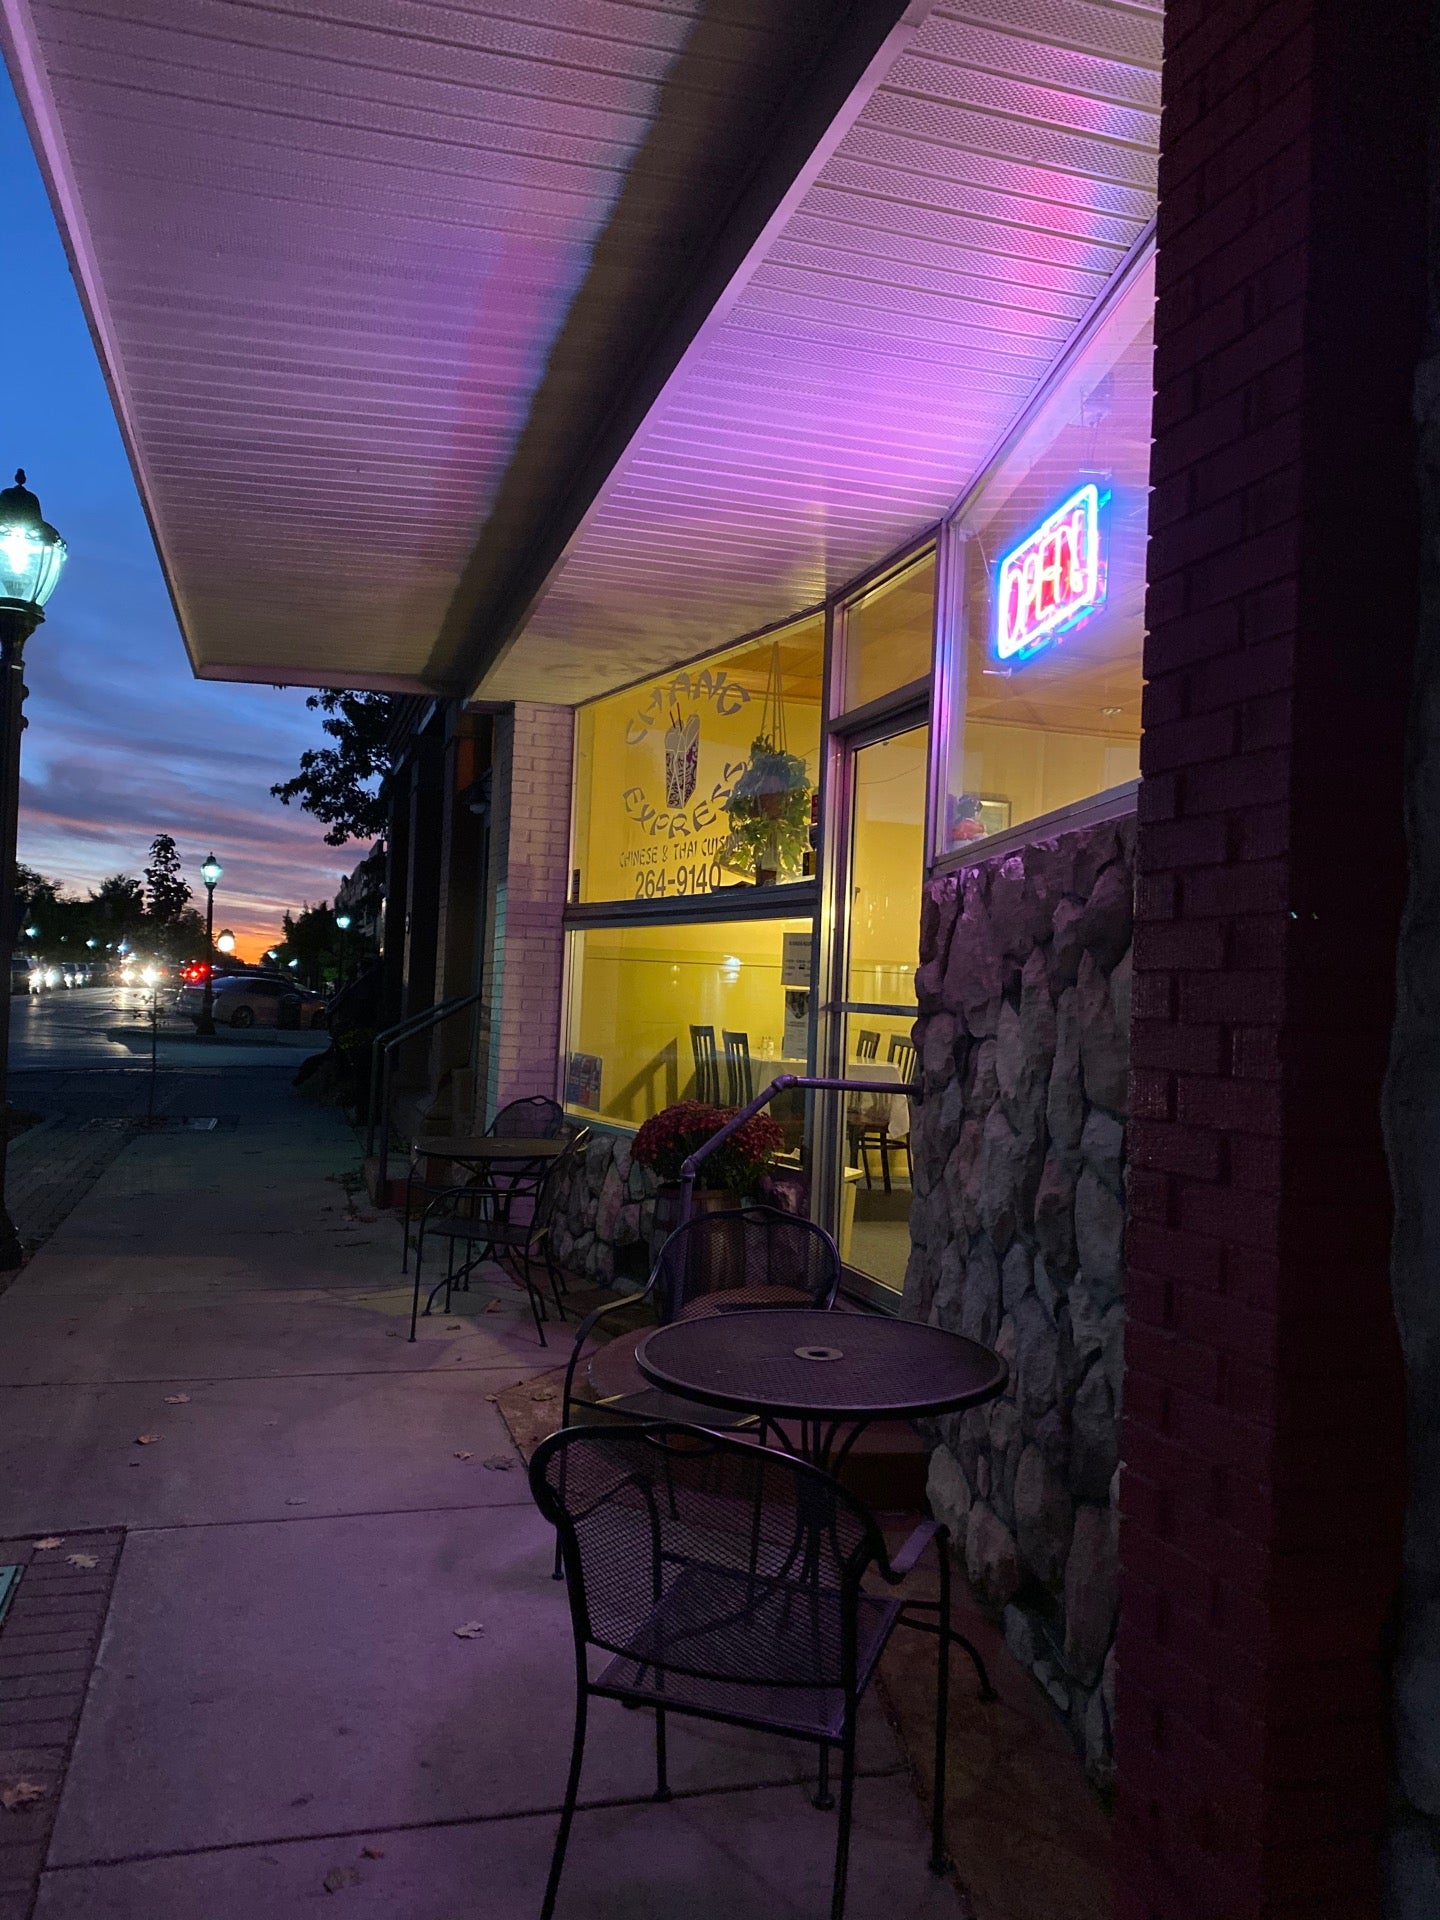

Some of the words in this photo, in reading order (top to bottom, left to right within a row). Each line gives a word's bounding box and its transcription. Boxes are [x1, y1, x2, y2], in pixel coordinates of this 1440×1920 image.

[1007, 509, 1085, 643] OPEN
[622, 761, 747, 838] EXPRESS
[619, 846, 658, 868] CHINESE
[662, 845, 668, 863] &
[674, 840, 698, 859] THAI
[635, 863, 721, 900] 264-9140
